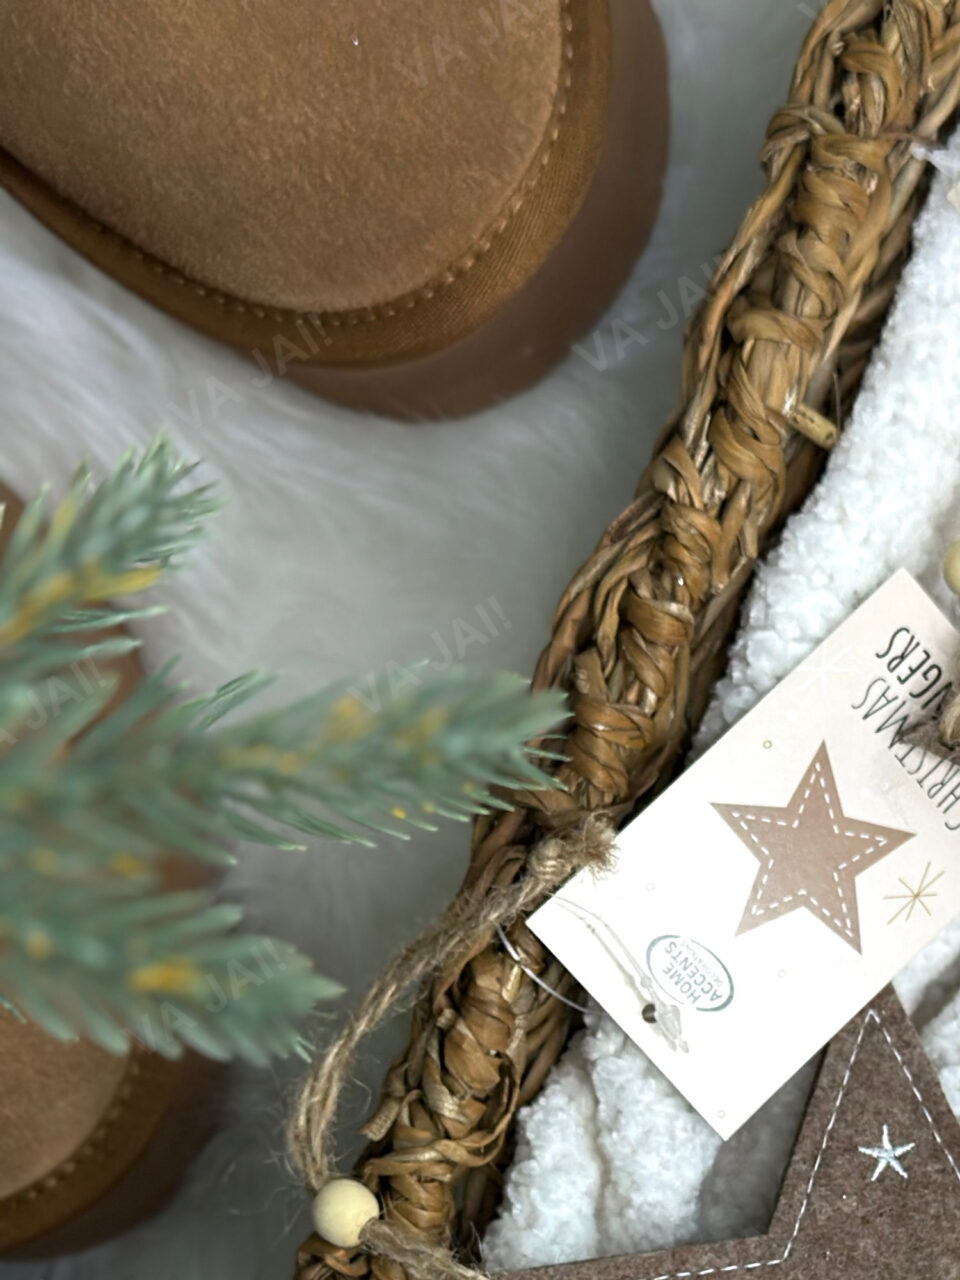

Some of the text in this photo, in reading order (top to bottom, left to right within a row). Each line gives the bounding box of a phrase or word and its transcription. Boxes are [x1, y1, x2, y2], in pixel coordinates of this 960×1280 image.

[875, 627, 953, 714] NGERS
[662, 962, 701, 1004] HOME
[664, 941, 723, 1002] ACCENTS
